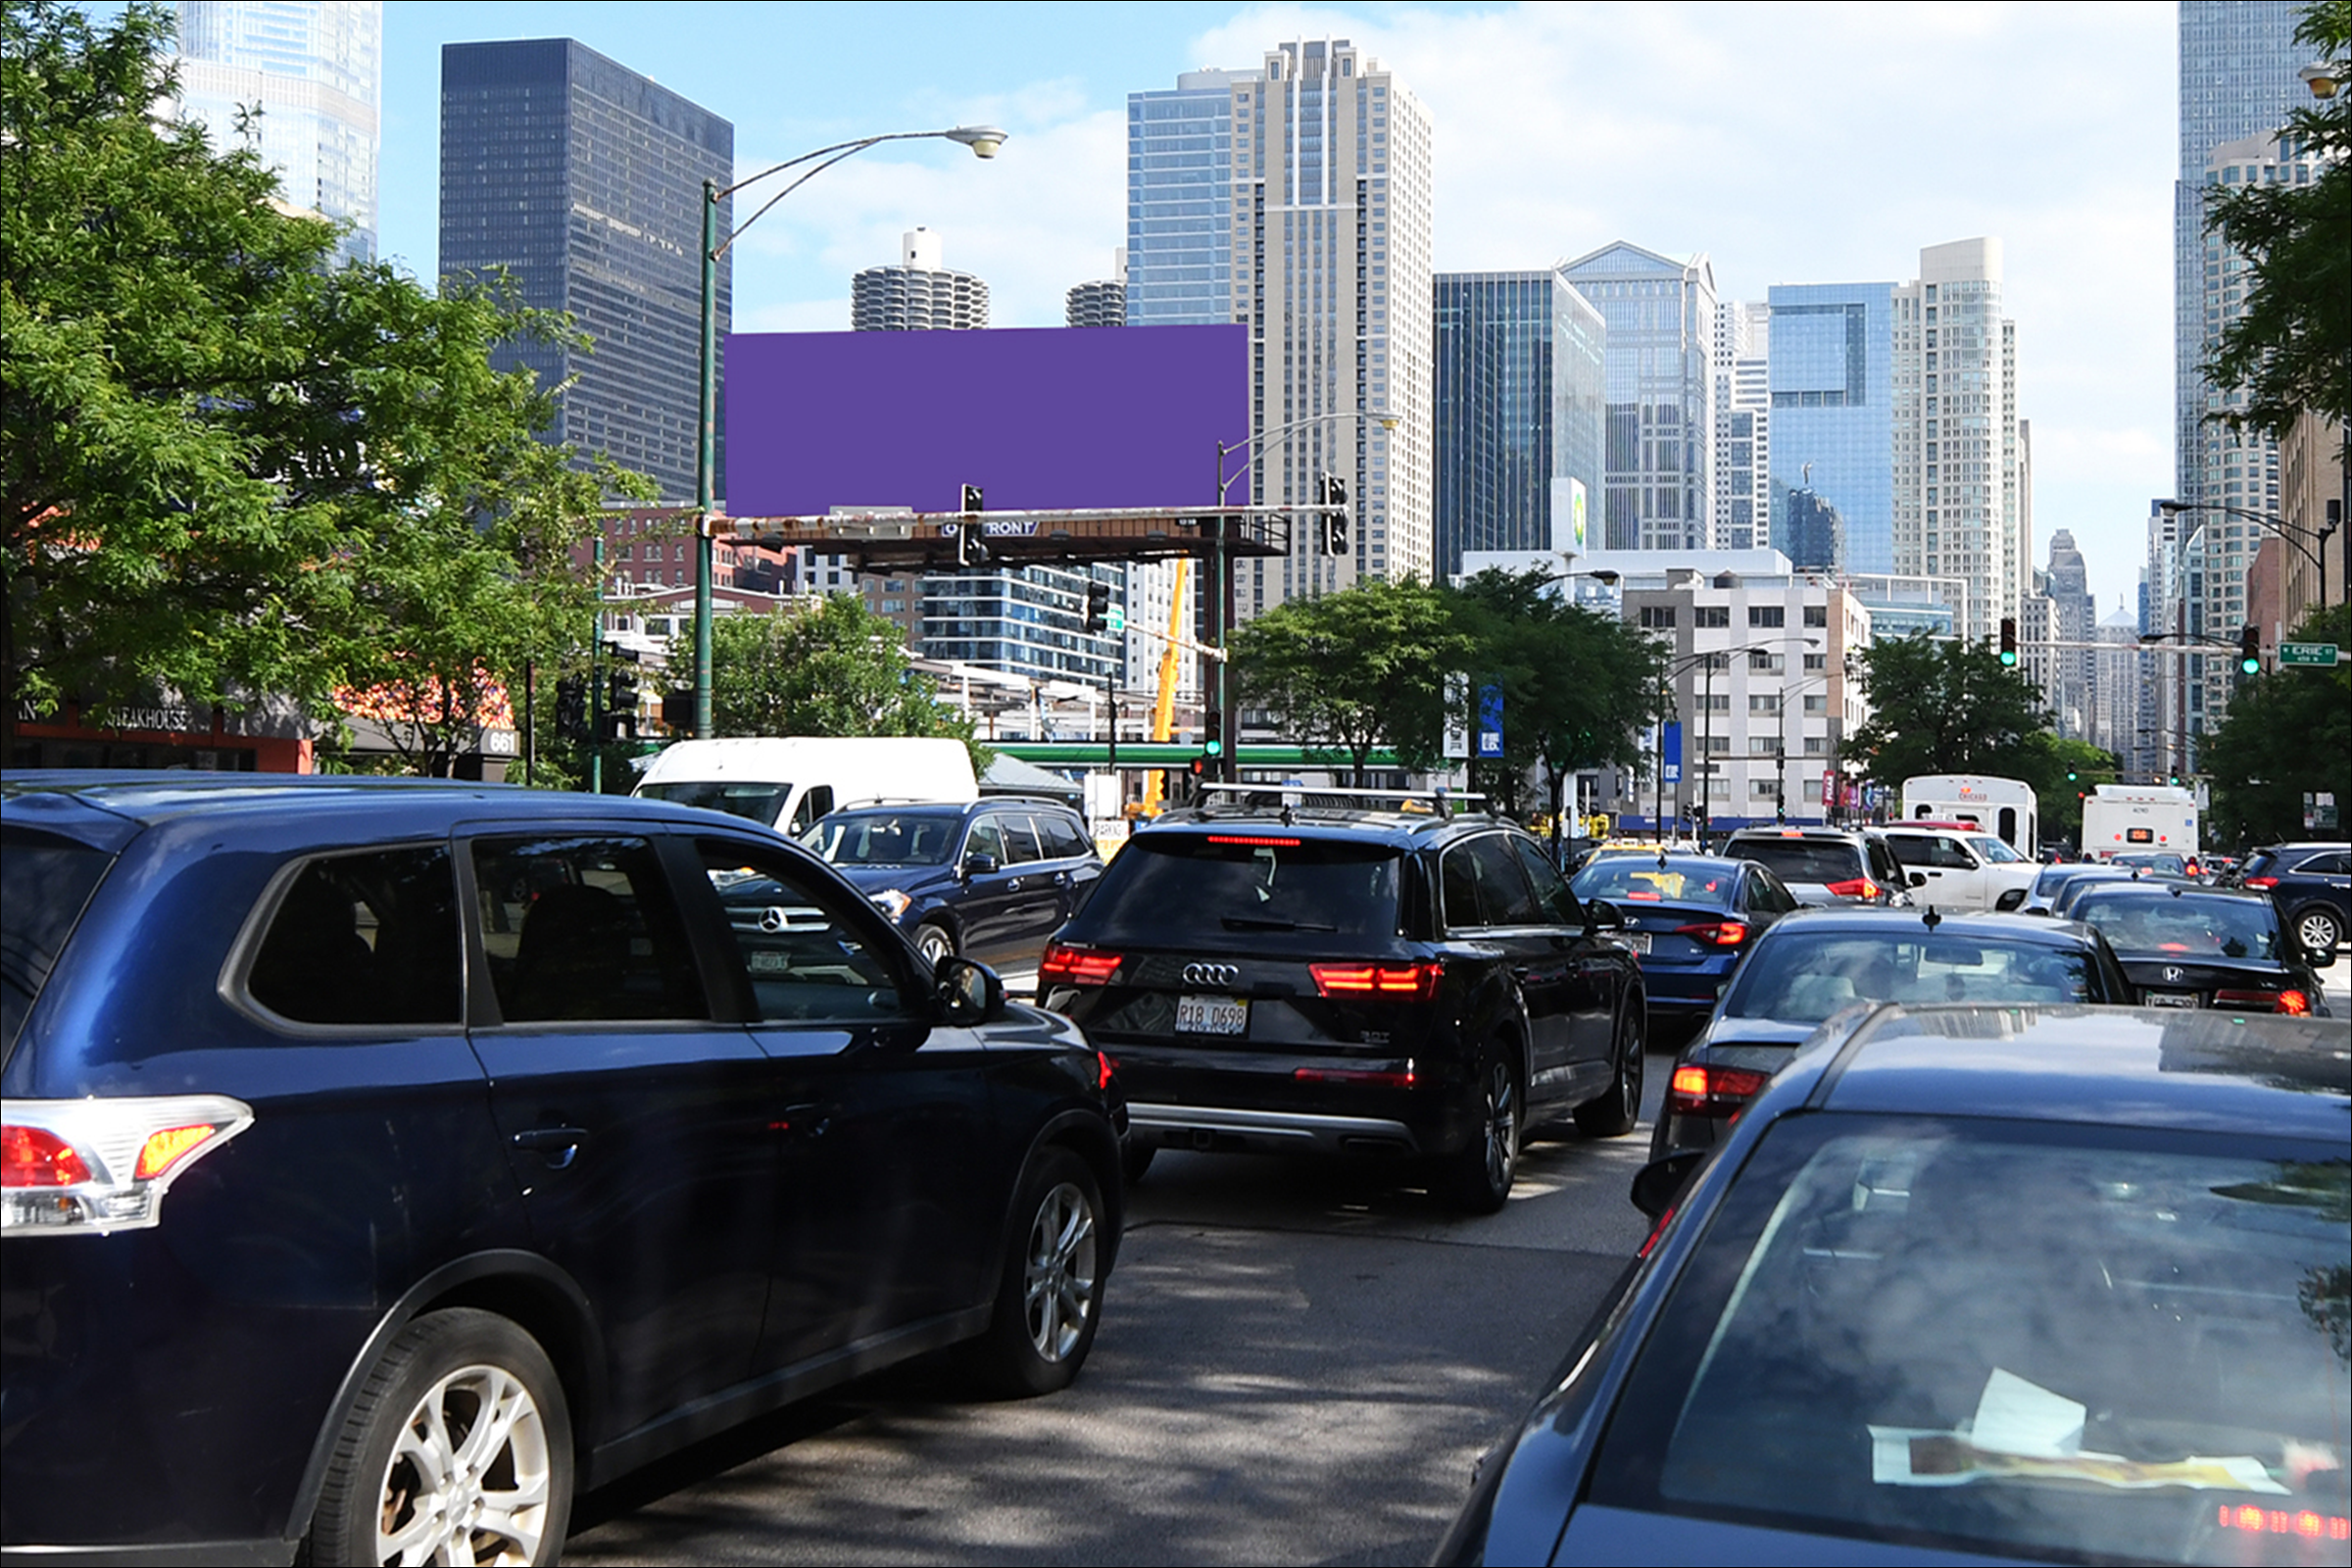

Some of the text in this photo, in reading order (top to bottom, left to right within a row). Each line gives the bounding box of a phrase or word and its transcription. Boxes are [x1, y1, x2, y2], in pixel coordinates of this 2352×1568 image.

[945, 521, 1035, 535] ORONT
[2292, 646, 2324, 657] ERIE
[490, 731, 515, 753] 661
[1179, 1004, 1246, 1028] R18 0698
